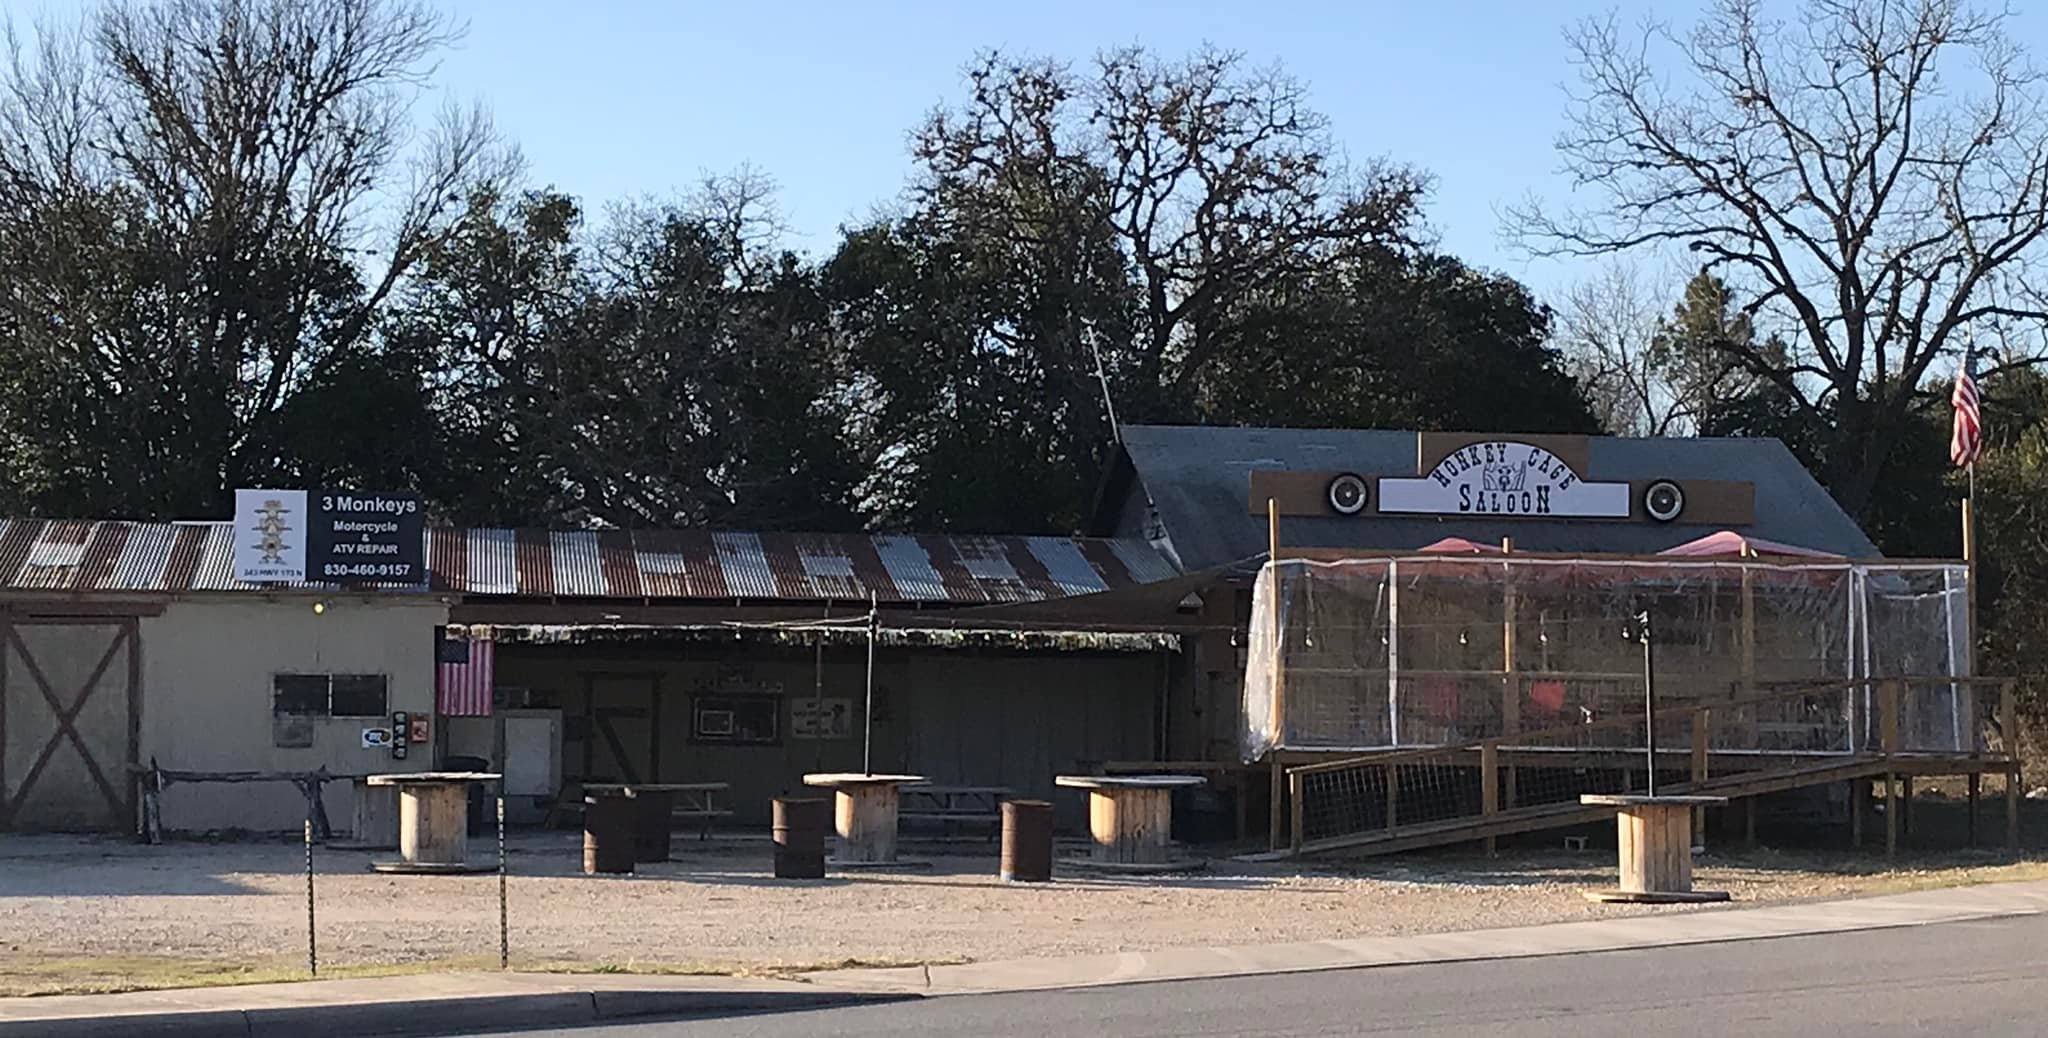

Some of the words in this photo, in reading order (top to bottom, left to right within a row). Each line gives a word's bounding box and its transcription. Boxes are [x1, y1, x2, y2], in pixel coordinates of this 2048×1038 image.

[1527, 449, 1577, 491] CAGE
[1460, 484, 1550, 513] SALOON
[322, 496, 333, 511] 3
[337, 496, 416, 515] Monkeys
[334, 520, 398, 534] Motorcycle
[361, 534, 370, 542] &
[333, 544, 354, 554] ATV
[357, 544, 398, 554] REPAIR
[260, 568, 279, 576] HWY
[324, 564, 411, 576] 830-460-9157
